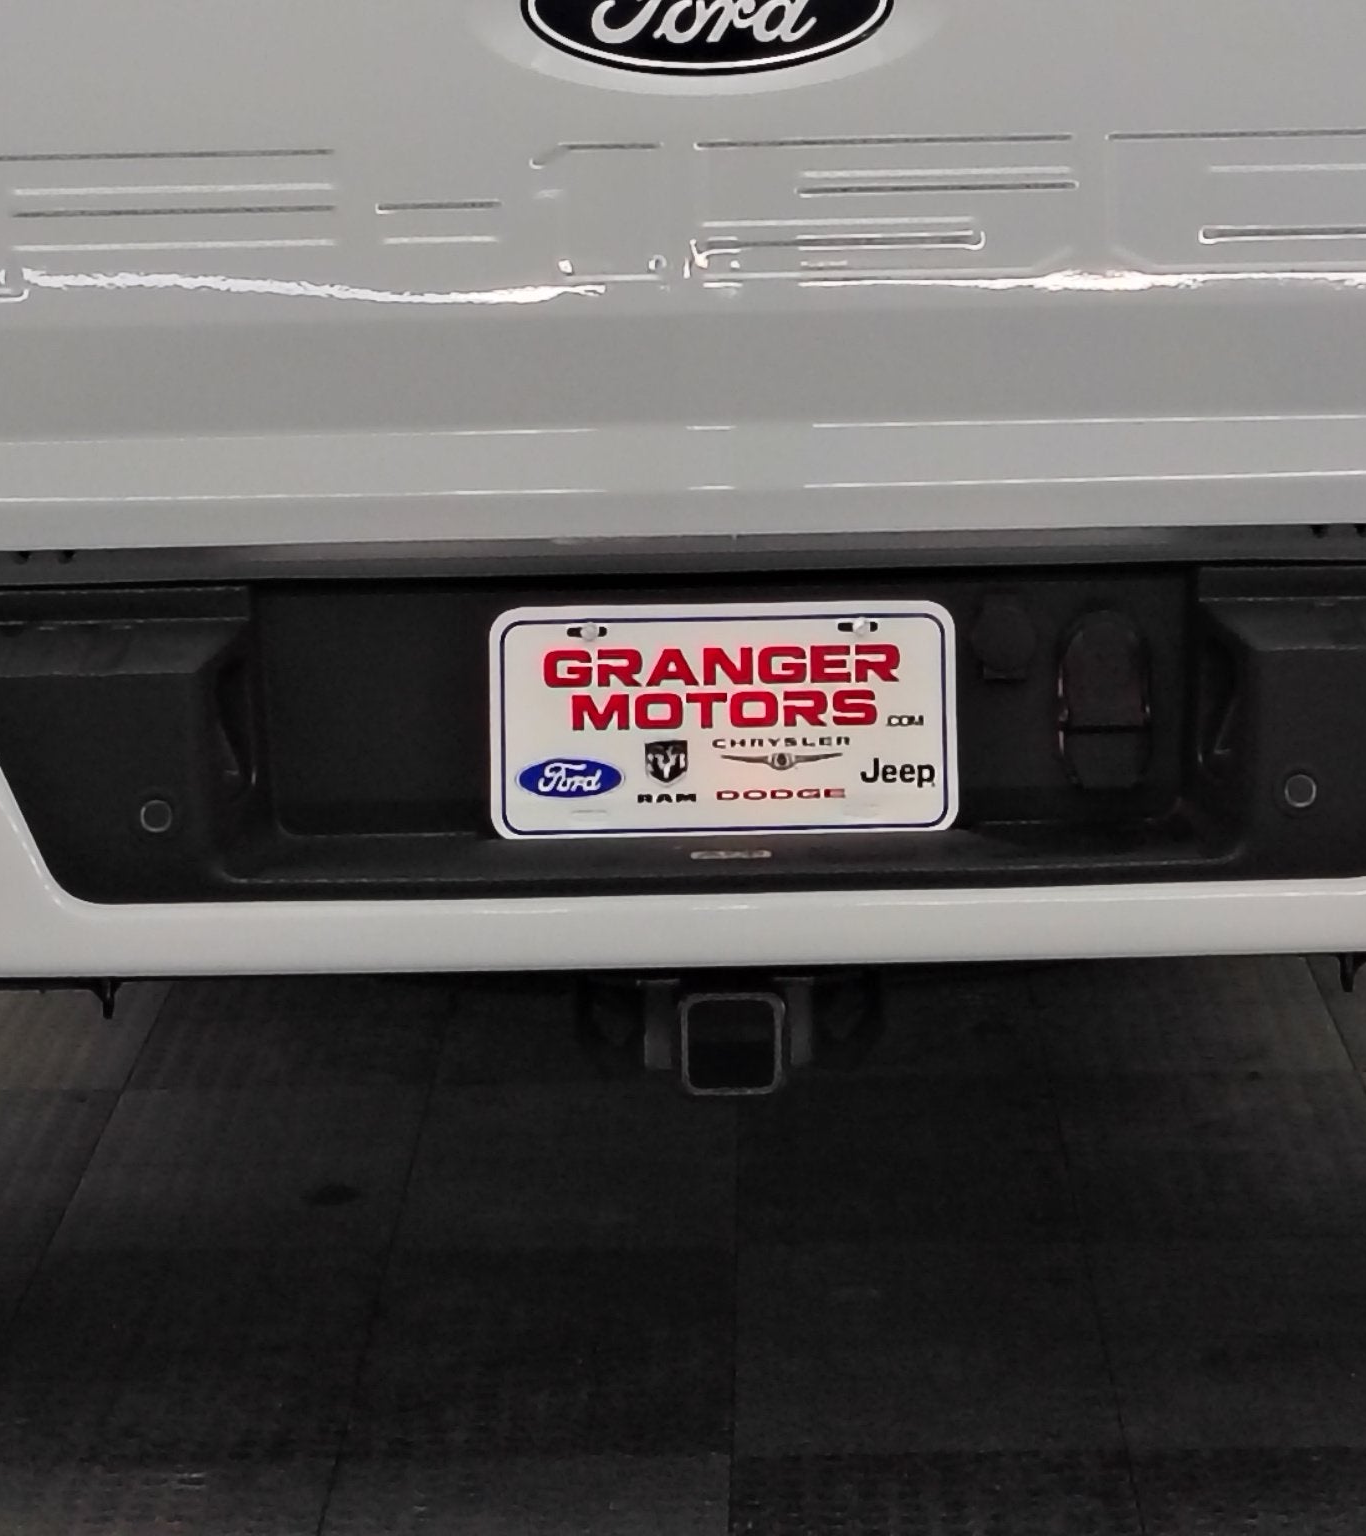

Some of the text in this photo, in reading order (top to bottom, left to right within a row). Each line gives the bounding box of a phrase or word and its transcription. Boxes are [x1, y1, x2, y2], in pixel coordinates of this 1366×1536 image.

[542, 643, 901, 689] GRANGER
[570, 689, 878, 732] MOTORS
[711, 735, 851, 749] CHRYSLER
[537, 762, 603, 793] Ford
[859, 757, 936, 789] Jeep
[636, 792, 698, 804] RAM
[715, 787, 847, 801] DODGE
